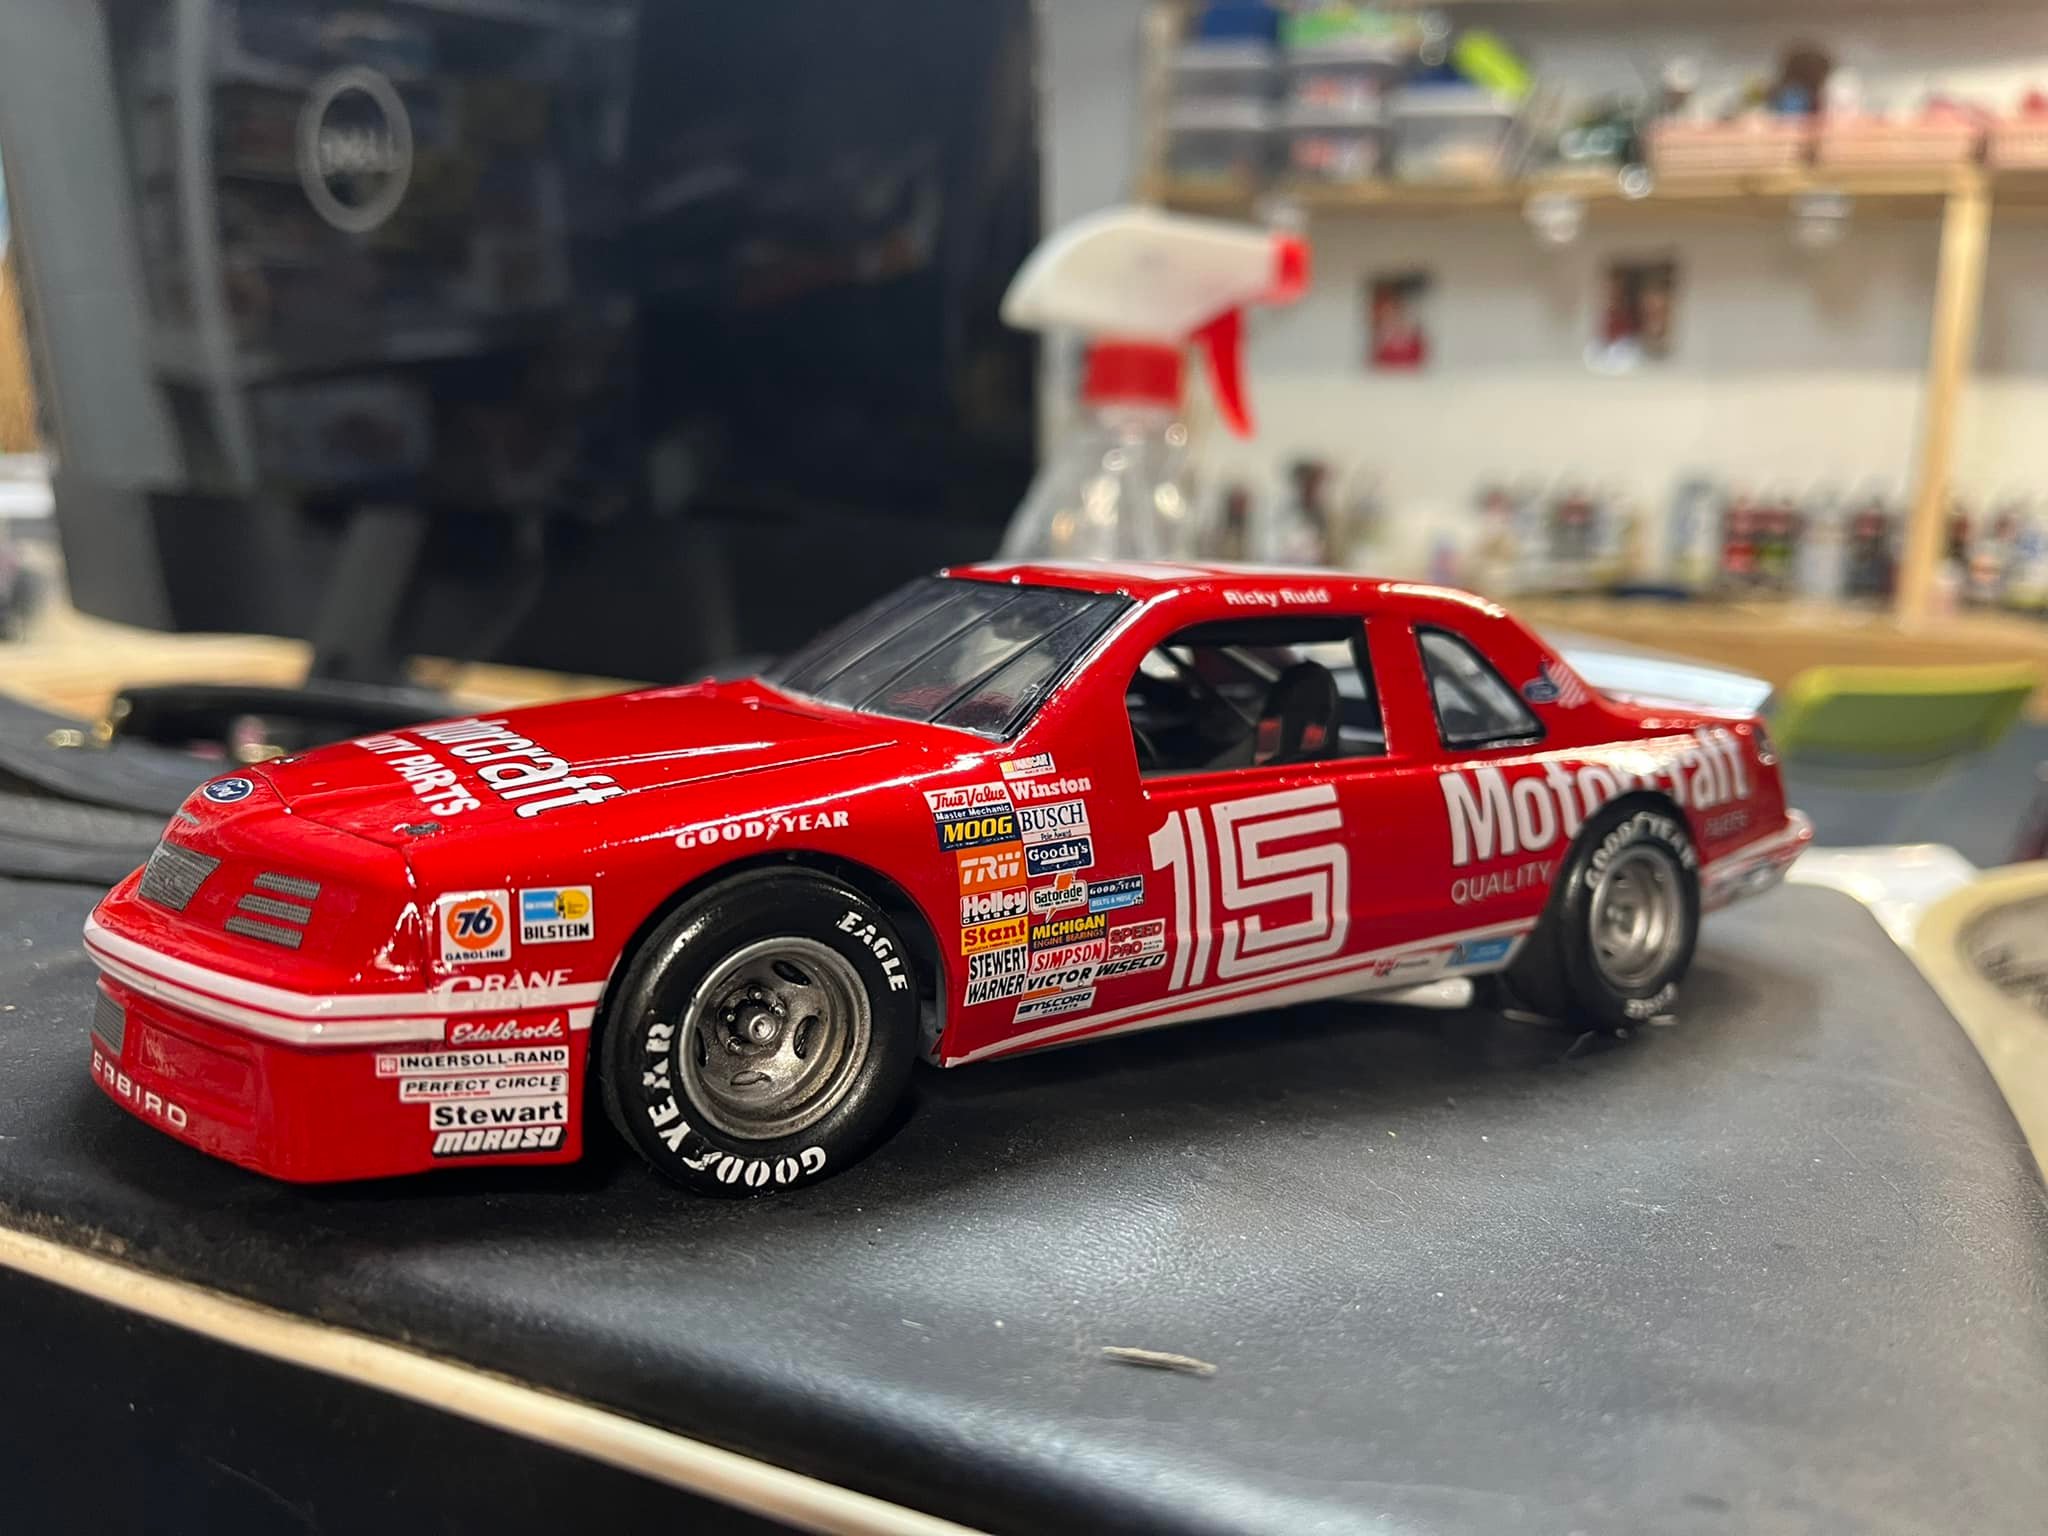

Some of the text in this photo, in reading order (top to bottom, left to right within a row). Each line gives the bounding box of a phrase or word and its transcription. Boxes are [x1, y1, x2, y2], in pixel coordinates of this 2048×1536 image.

[1222, 586, 1330, 608] Ricky Rudd
[386, 754, 481, 816] PARTS
[1009, 777, 1091, 800] Winston
[968, 804, 1010, 816] Mechanic
[1020, 802, 1084, 832] BUSCH
[675, 810, 849, 849] GOODYEAR
[943, 815, 1013, 843] MOOG
[1028, 842, 1089, 866] Goody's
[961, 851, 1022, 885] TRW
[1034, 885, 1083, 905] Gatorade
[1089, 880, 1141, 895] GOODYEAR
[1148, 783, 1349, 991] 15
[1450, 860, 1552, 906] QUALITY
[962, 891, 1027, 919] Holley
[457, 906, 494, 936] 76
[524, 922, 590, 941] BILSTEIN
[964, 919, 1026, 948] Stant
[1032, 913, 1106, 940] MICHIGAN
[1110, 922, 1163, 943] SPEED
[445, 949, 506, 961] GASOLINE
[836, 911, 909, 992] EAGLE
[1033, 936, 1063, 949] ENGINE
[1109, 940, 1143, 959] PRO
[1034, 942, 1103, 973] SIMPSON
[1095, 953, 1165, 977] WISECO
[967, 973, 1026, 1005] WARNER
[1027, 967, 1093, 991] VICTOR
[451, 1017, 563, 1044] Edelbrock
[400, 1050, 566, 1068] INGERSOLL-RAND
[405, 1075, 562, 1093] PERFECT CIRCLE
[434, 1100, 564, 1127] Stewart
[643, 1022, 827, 1188] GOODYEAR
